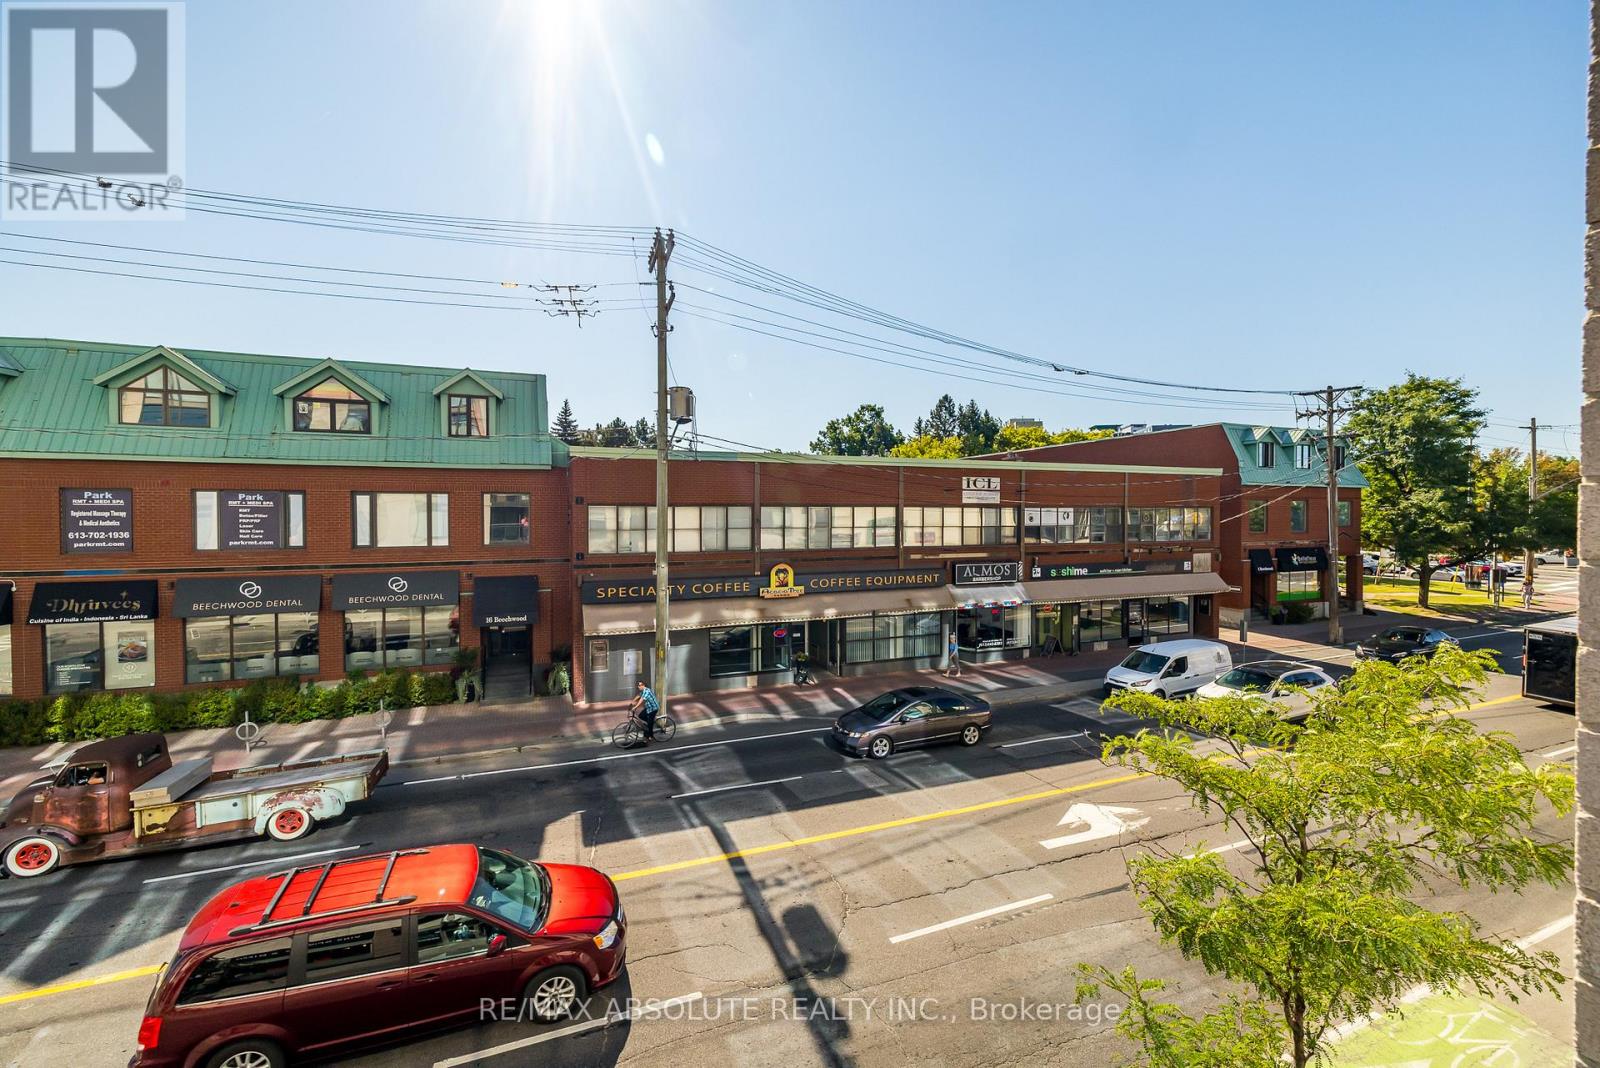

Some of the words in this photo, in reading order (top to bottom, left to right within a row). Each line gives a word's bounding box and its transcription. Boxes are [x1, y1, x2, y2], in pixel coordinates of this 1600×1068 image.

[84, 491, 113, 499] Park
[238, 493, 264, 501] Park
[68, 531, 130, 539] 613-702-1936
[73, 541, 125, 549] parkrmt.com
[810, 577, 861, 589] COFFEE
[866, 573, 941, 586] EQUIPMENT
[596, 583, 687, 599] SPECIATY
[692, 581, 751, 594] COFFEE
[348, 594, 409, 604] BEECHWOOD
[411, 592, 444, 601] DENTAL
[192, 600, 263, 611] BEECHWOOD
[265, 599, 303, 608] DENTAL
[493, 614, 528, 623] Beechwood
